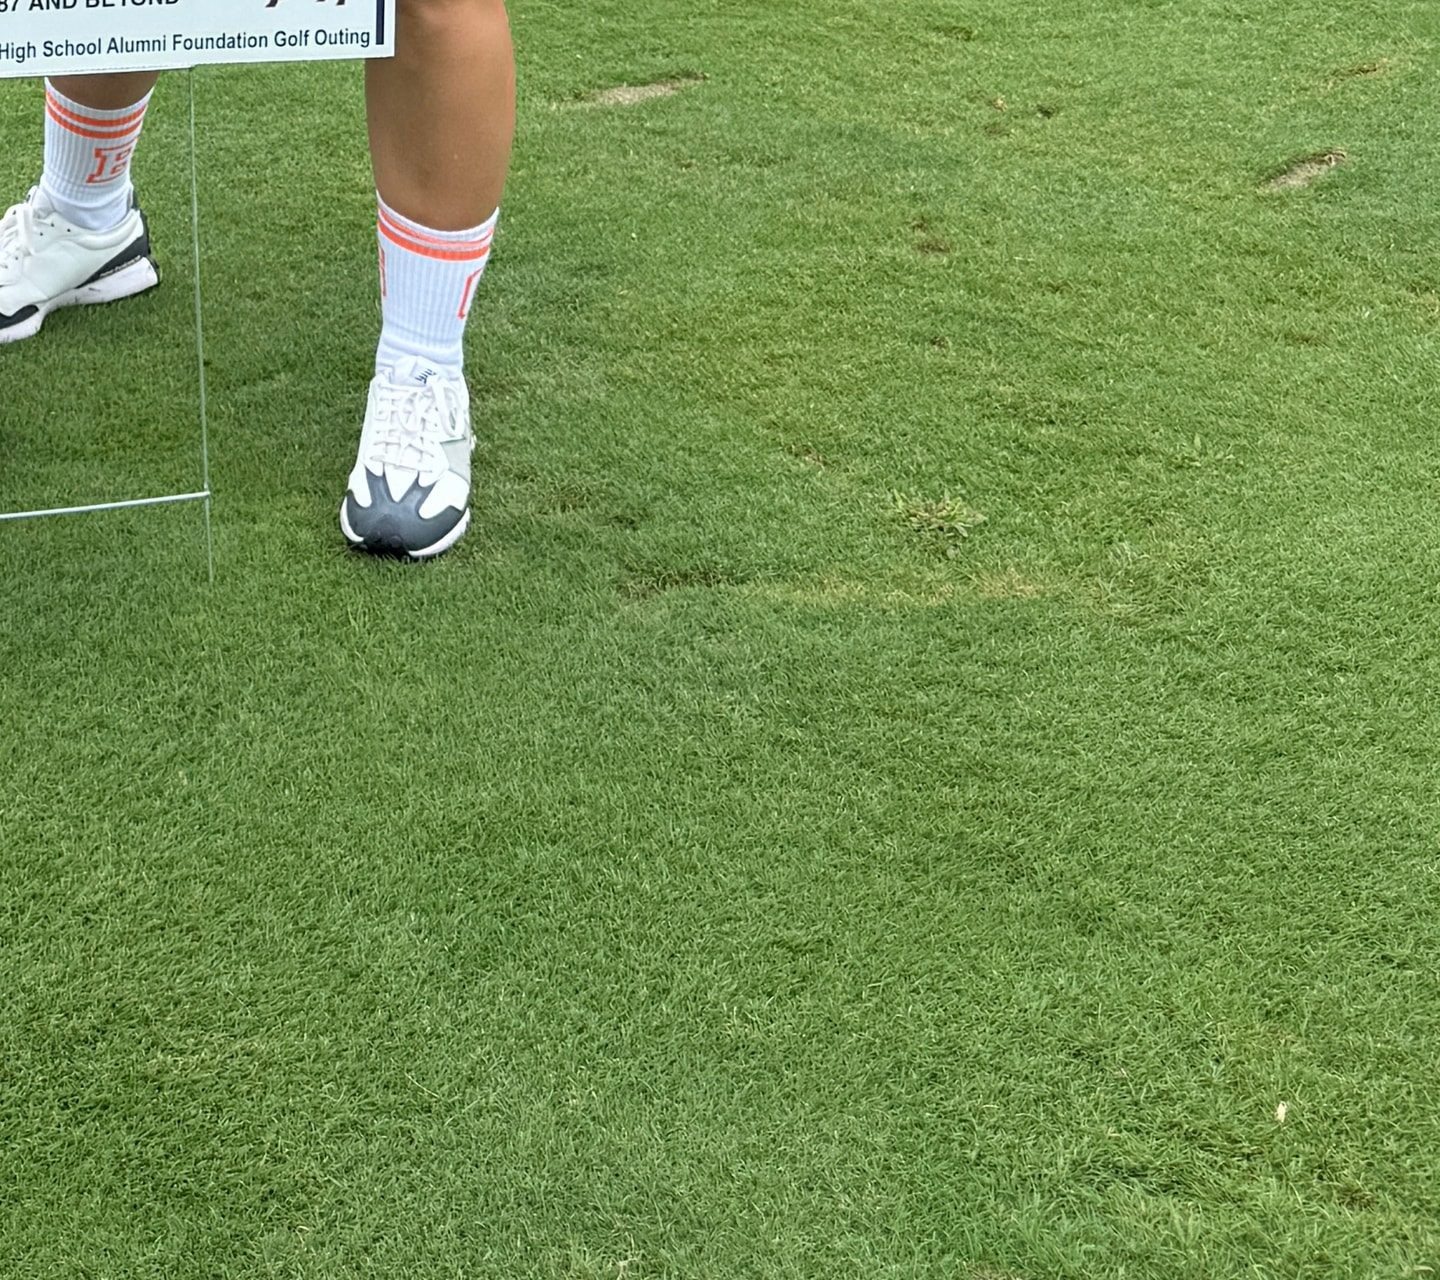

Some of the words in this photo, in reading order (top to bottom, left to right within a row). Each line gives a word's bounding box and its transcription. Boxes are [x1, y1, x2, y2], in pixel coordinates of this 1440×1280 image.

[43, 38, 101, 57] School
[107, 35, 166, 54] Alumni
[173, 33, 268, 50] Foundation
[274, 30, 310, 47] Golf
[315, 28, 370, 48] Outing
